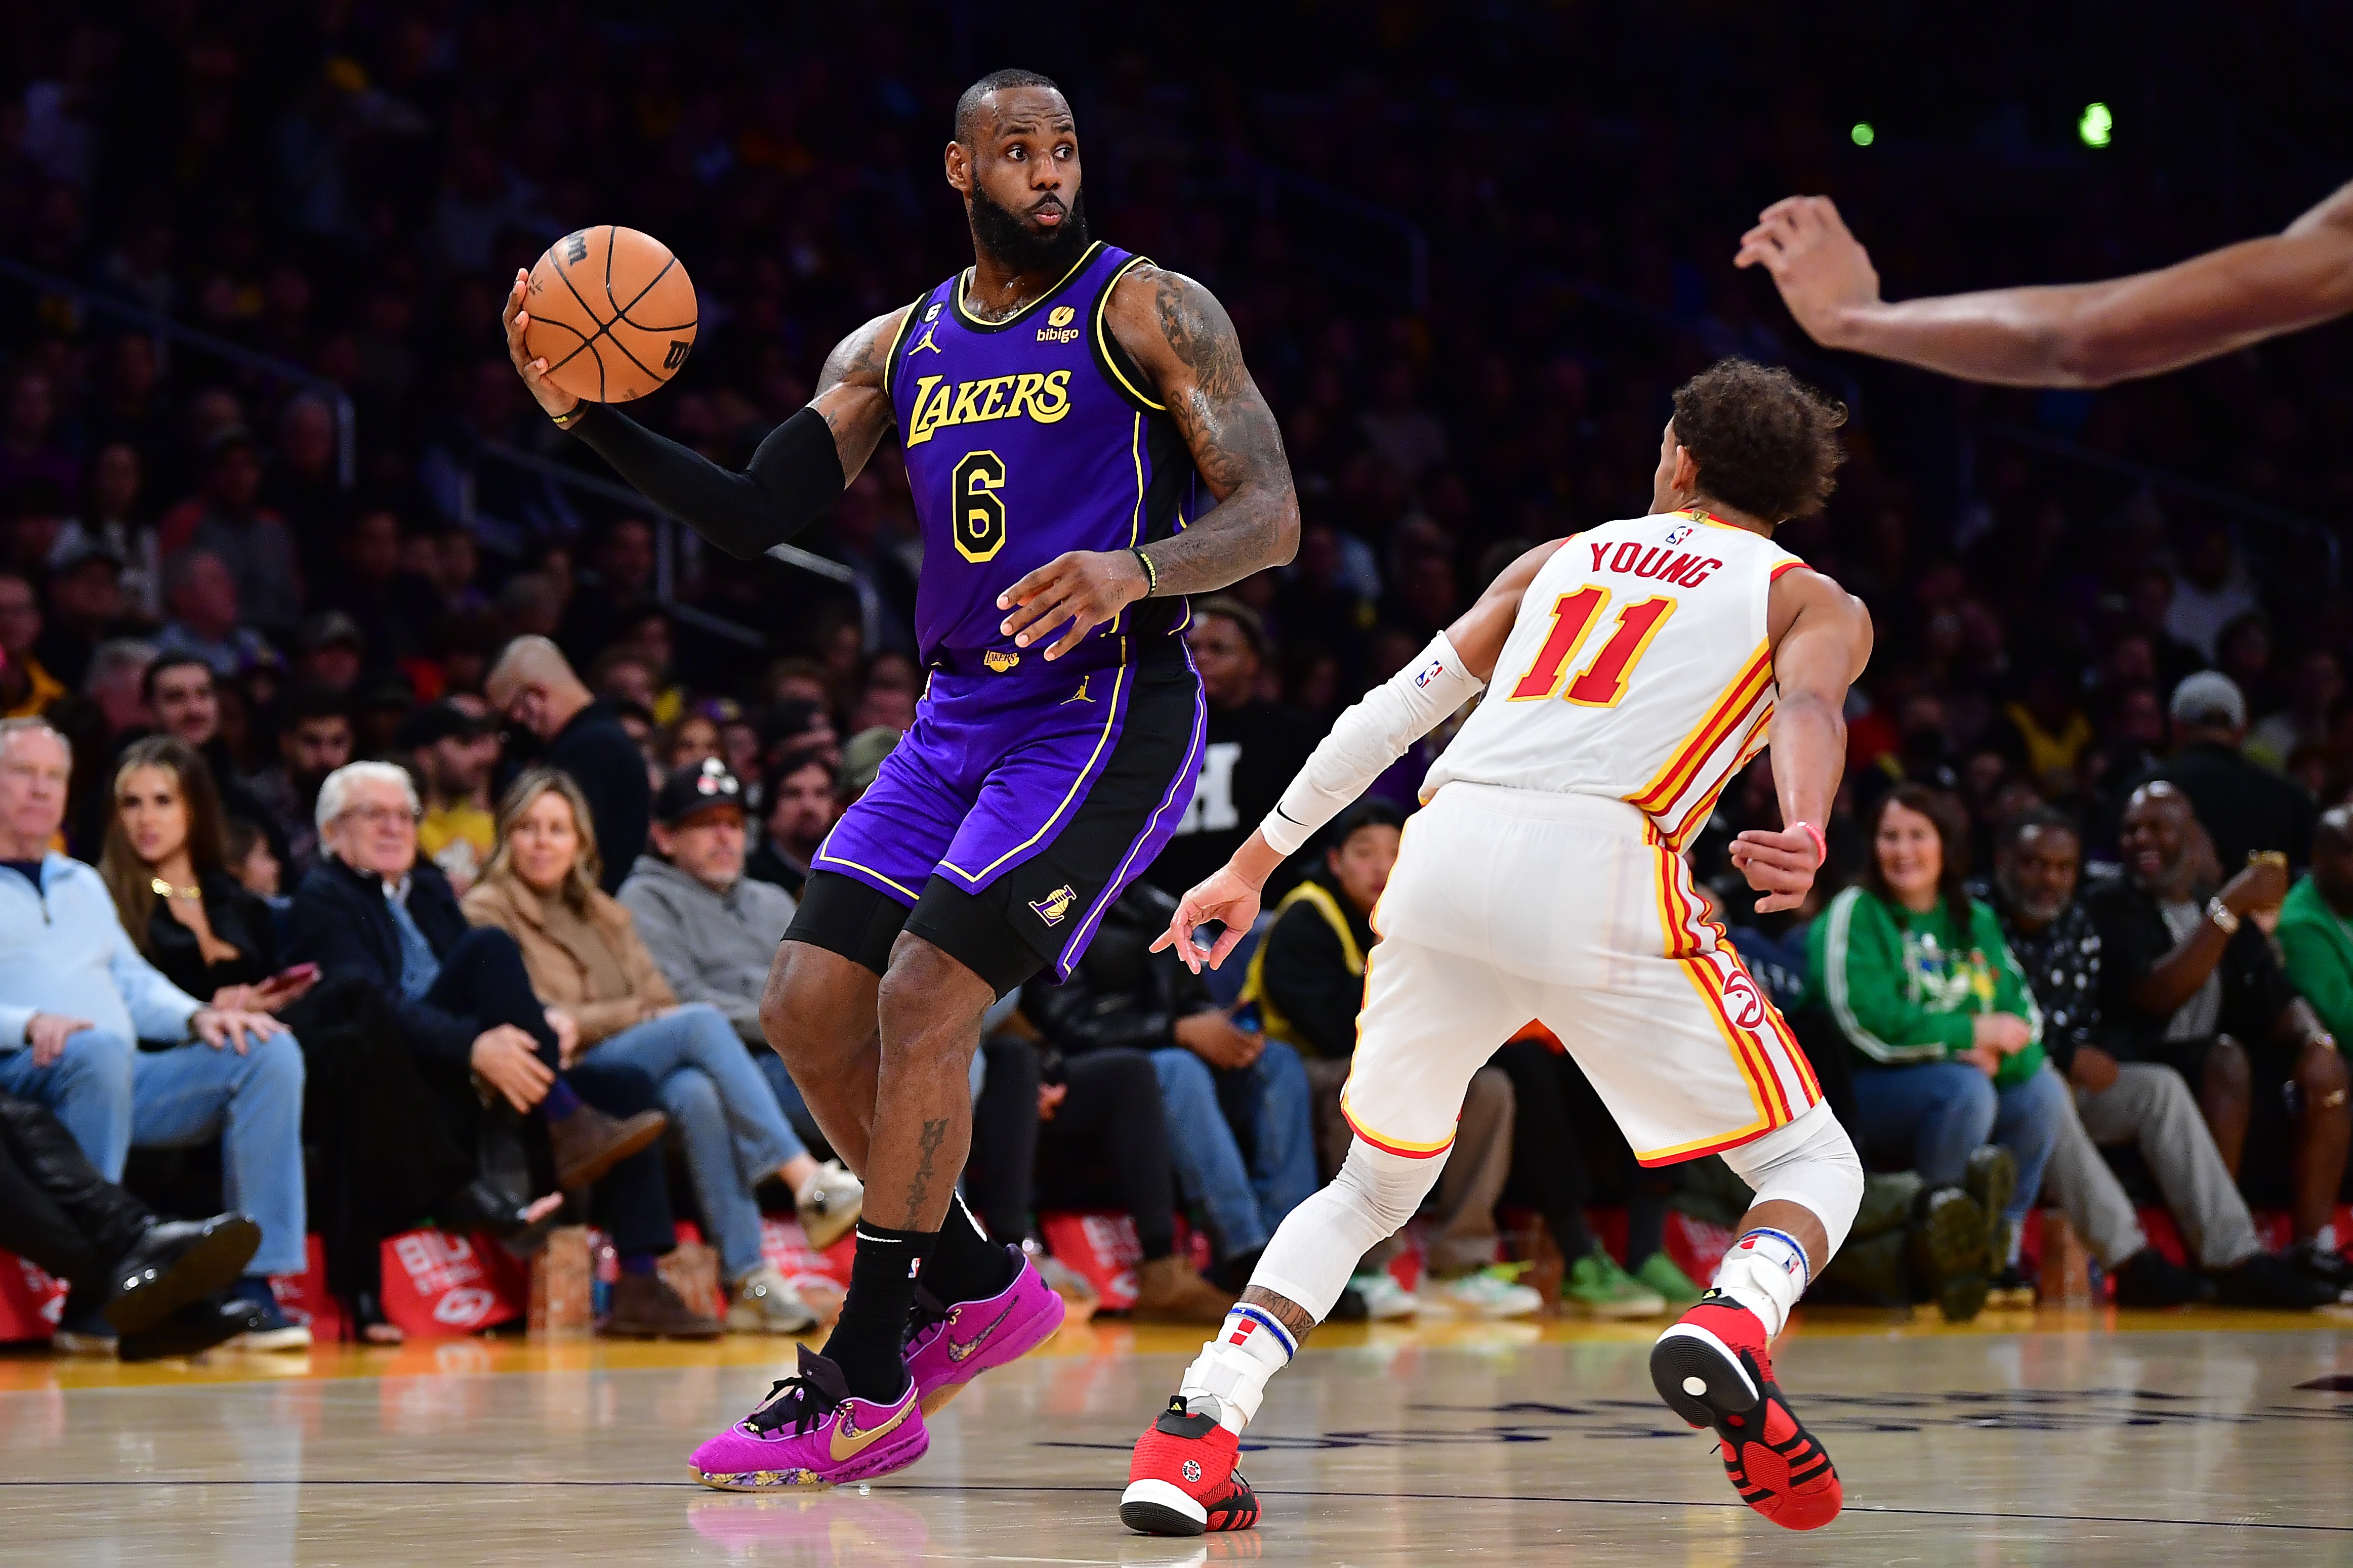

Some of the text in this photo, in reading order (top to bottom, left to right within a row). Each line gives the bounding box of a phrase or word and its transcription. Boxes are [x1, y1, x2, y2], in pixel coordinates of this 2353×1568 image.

[924, 303, 942, 322] 6
[1036, 328, 1080, 344] bibigo
[907, 370, 1071, 449] LAKERS
[952, 450, 1006, 564] 6
[1140, 553, 1157, 587] PROMISE
[1590, 542, 1723, 588] YOUNG
[1506, 583, 1678, 708] 11
